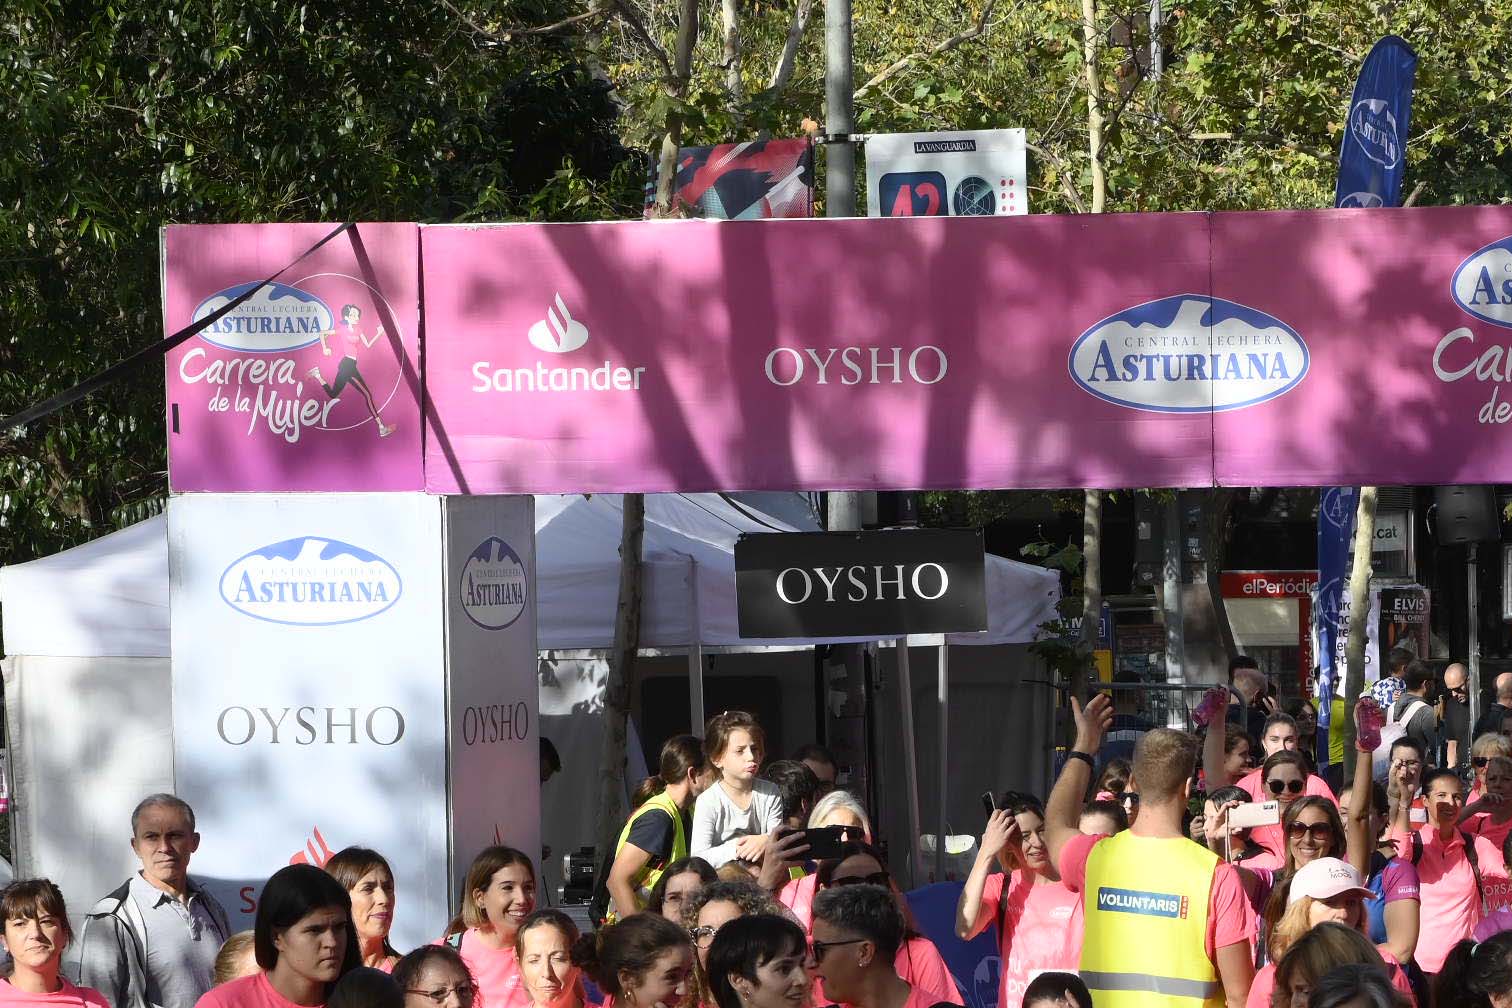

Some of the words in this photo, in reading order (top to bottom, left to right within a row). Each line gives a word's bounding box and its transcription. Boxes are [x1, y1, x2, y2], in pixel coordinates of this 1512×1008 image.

[926, 141, 974, 152] VANGUARDIA
[203, 308, 322, 334] ASTURIANA
[230, 304, 268, 313] ENTRAL
[272, 304, 319, 313] LECHERA
[1124, 335, 1199, 348] CENTRAL
[1206, 334, 1283, 347] LECHERA
[179, 348, 296, 385] Carrera
[472, 360, 646, 393] Santander
[764, 345, 948, 386] OYSHO
[1088, 338, 1290, 383] ASTURIANA
[208, 388, 229, 412] de
[234, 385, 250, 412] la
[248, 381, 340, 443] Mujer
[233, 569, 390, 603] ASTURIANA
[465, 572, 524, 607] ASTURIANA
[775, 562, 949, 605] OYSHO
[1394, 597, 1425, 611] ELVIS
[217, 706, 405, 746] OYSHO
[463, 701, 529, 746] OYSHO
[1099, 893, 1178, 913] VOLUNTARIS
